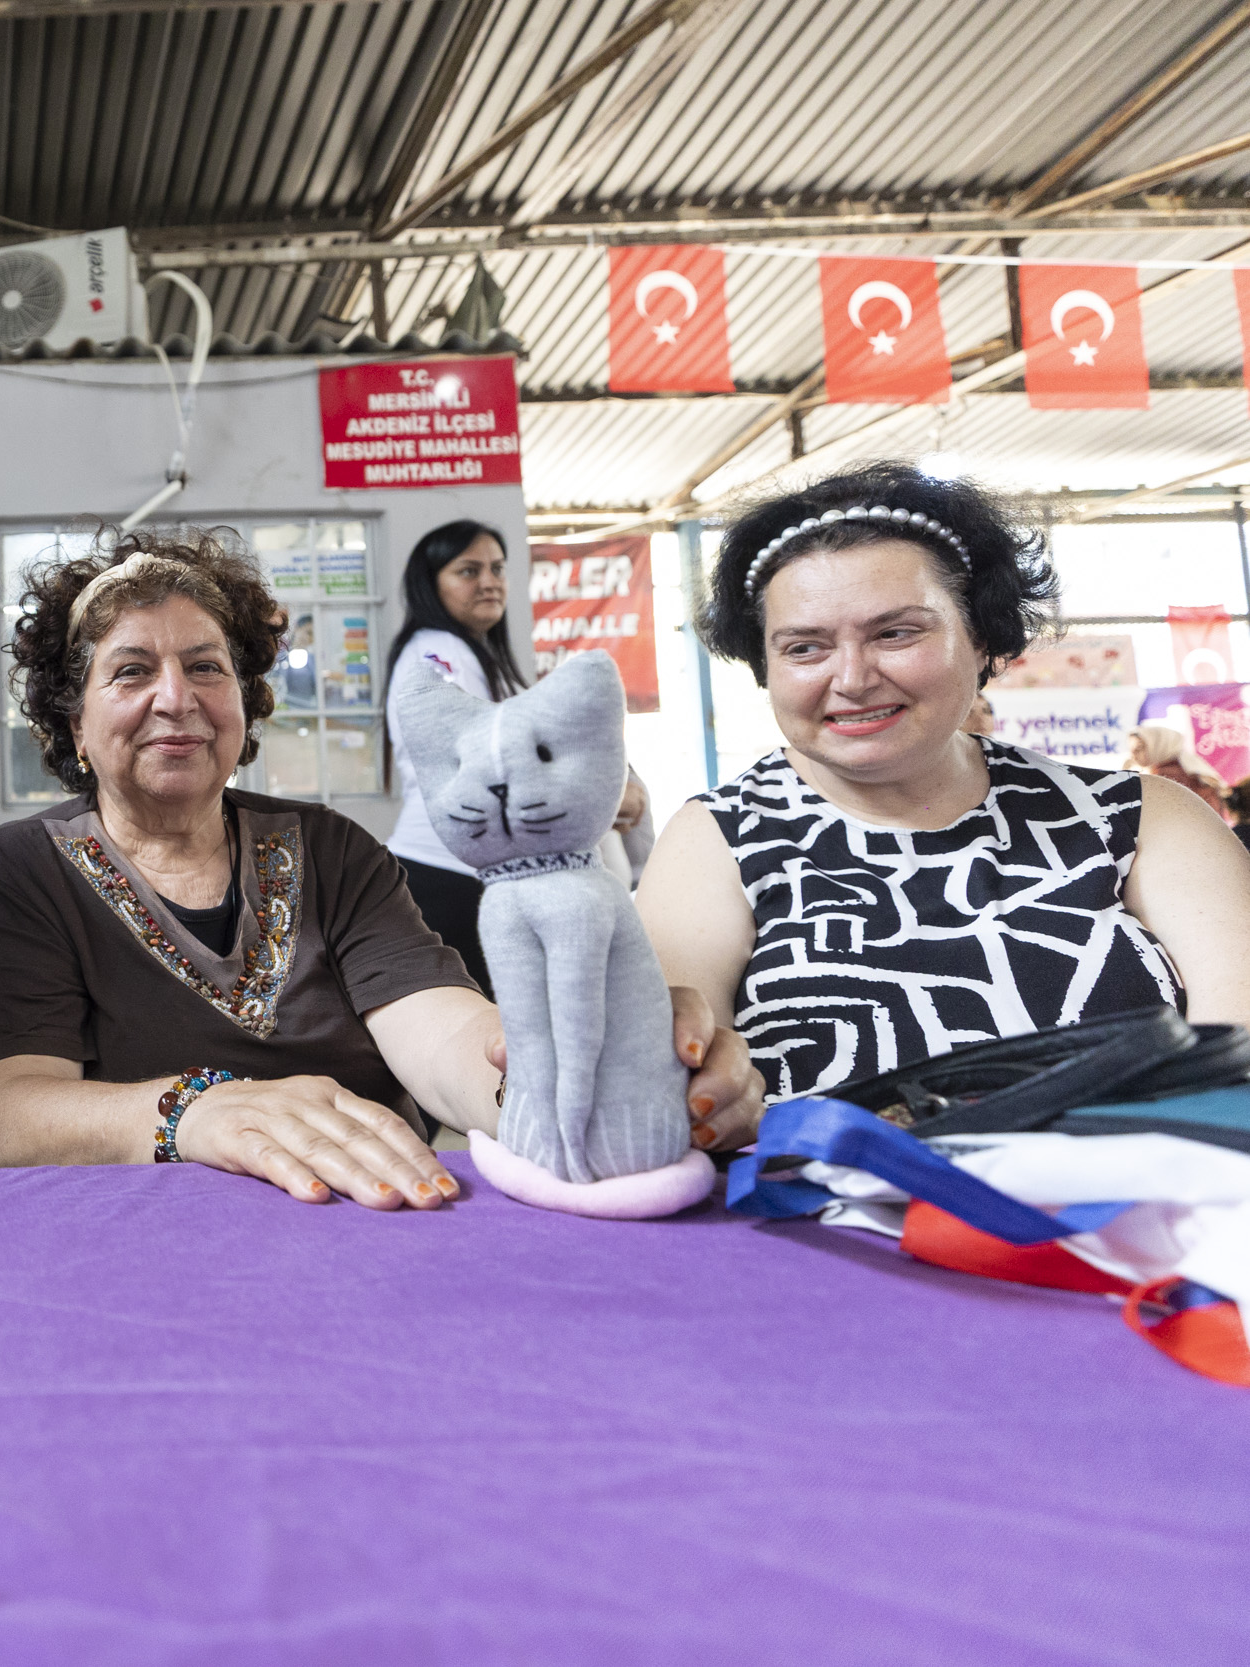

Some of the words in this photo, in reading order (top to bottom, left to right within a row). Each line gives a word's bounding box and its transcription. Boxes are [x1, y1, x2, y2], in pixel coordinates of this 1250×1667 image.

[400, 369, 435, 386] T.C.
[368, 390, 440, 411] MERSİN
[346, 414, 431, 436] AKDENİZ
[434, 409, 495, 435] İLÇESİ
[326, 438, 416, 461] MESUDİYE
[419, 433, 518, 457] MAHALLESİ
[364, 461, 482, 483] MUHTARLIĞI
[1018, 706, 1120, 738] yetenek
